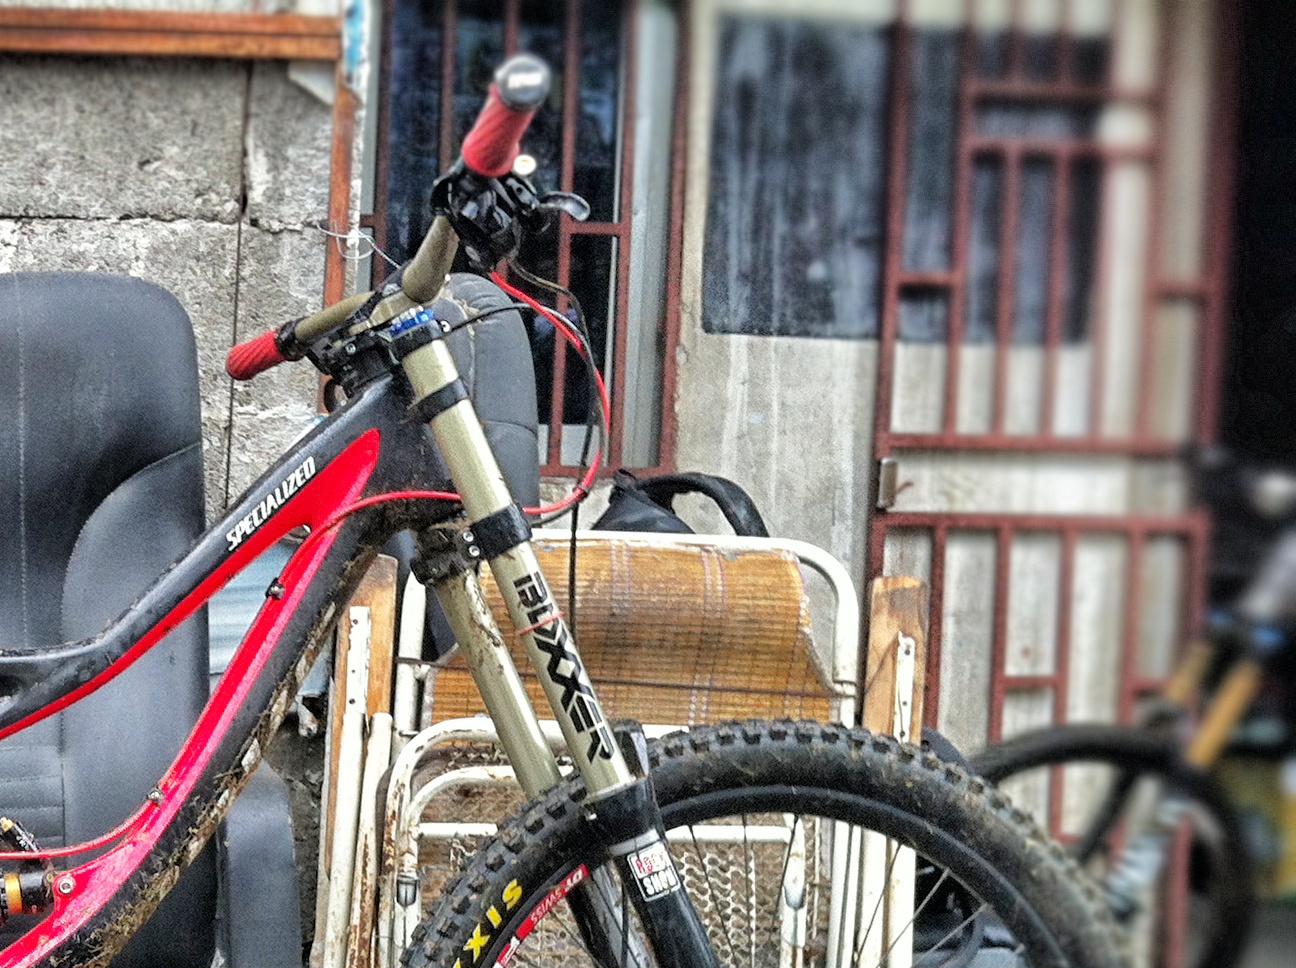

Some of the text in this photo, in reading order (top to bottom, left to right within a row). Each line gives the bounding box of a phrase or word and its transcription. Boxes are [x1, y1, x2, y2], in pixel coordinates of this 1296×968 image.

[226, 456, 316, 551] SPECIALIZED
[513, 571, 615, 765] BOXXER
[530, 885, 565, 923] SWISS
